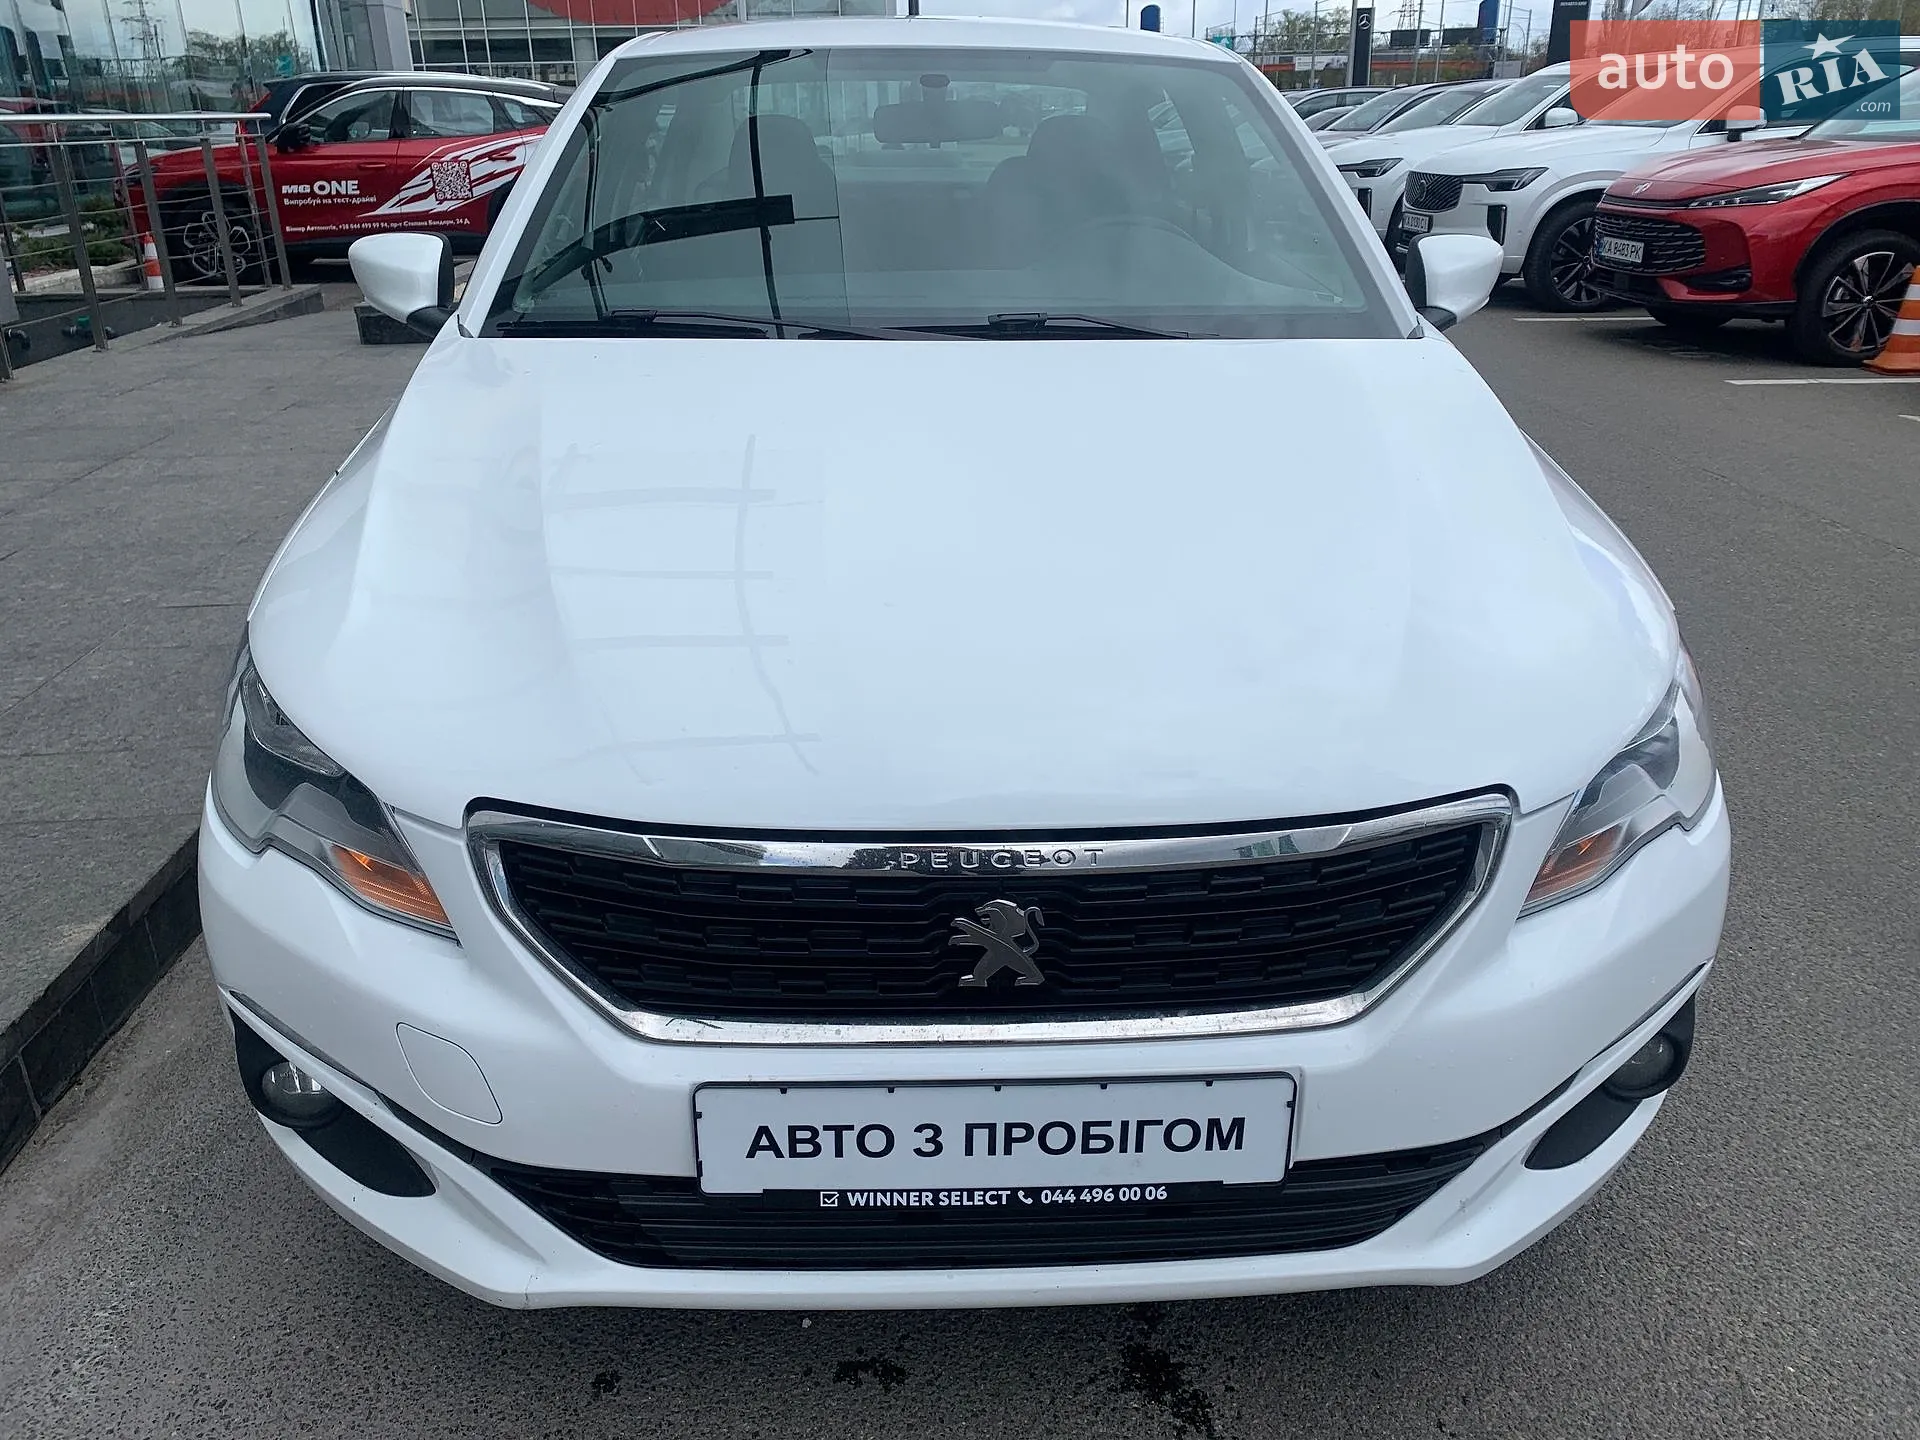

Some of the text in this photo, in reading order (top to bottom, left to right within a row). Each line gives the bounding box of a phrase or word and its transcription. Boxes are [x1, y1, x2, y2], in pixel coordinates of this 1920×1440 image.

[282, 180, 360, 195] MG ONE
[284, 197, 321, 206] Випробуй
[333, 195, 377, 204] тест-драйві
[900, 849, 1103, 869] PEUGEOT
[746, 1124, 895, 1159] АВТО
[965, 1117, 1246, 1156] ПРОБІГОМ
[847, 1186, 1168, 1207] WINNER SELECT 044 496 00 06
